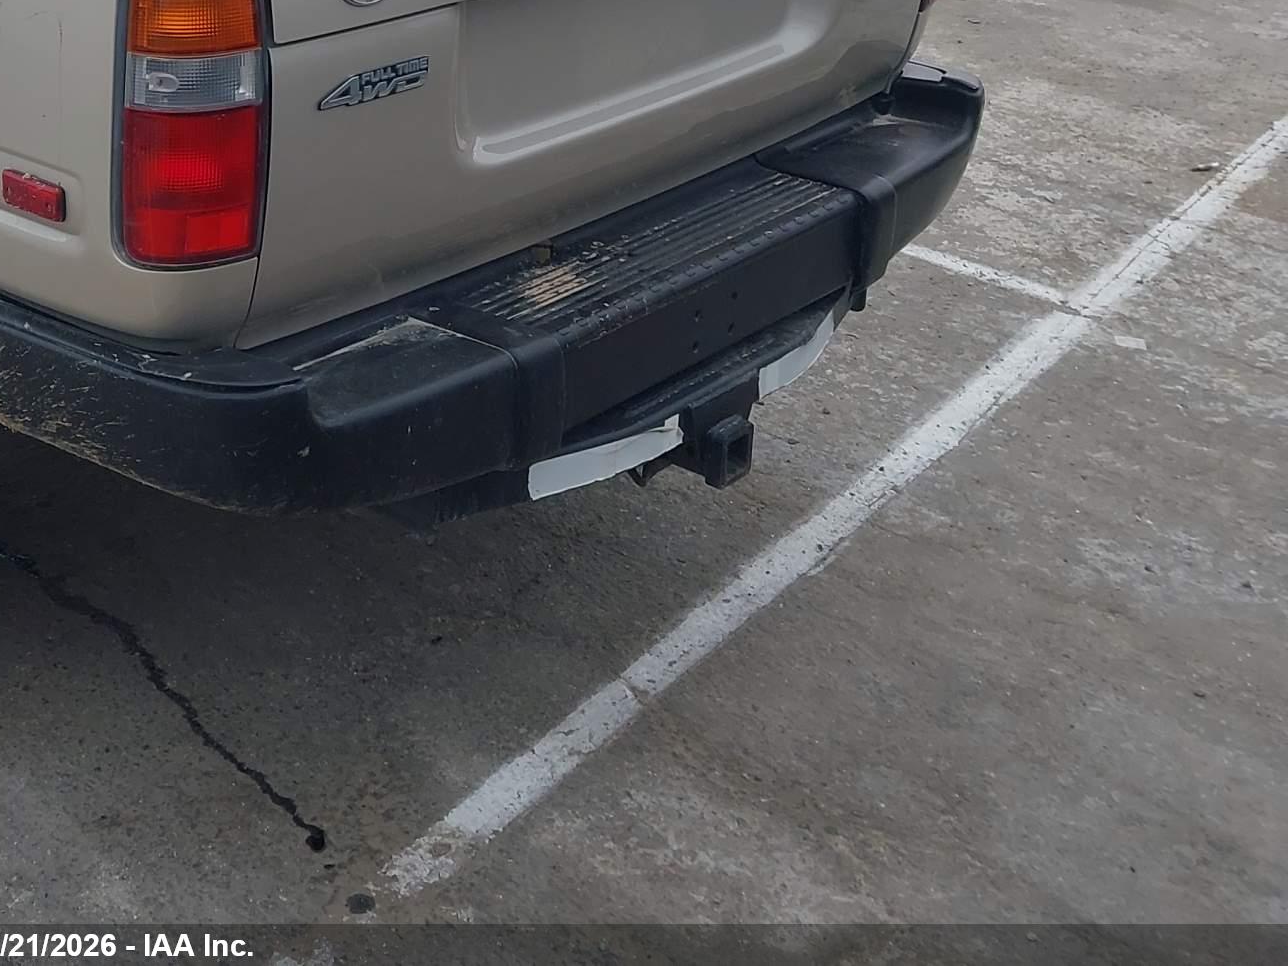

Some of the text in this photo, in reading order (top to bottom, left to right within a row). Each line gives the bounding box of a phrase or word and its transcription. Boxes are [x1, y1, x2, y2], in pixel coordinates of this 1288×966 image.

[362, 58, 428, 85] FULL TIME
[319, 71, 428, 111] 4WD
